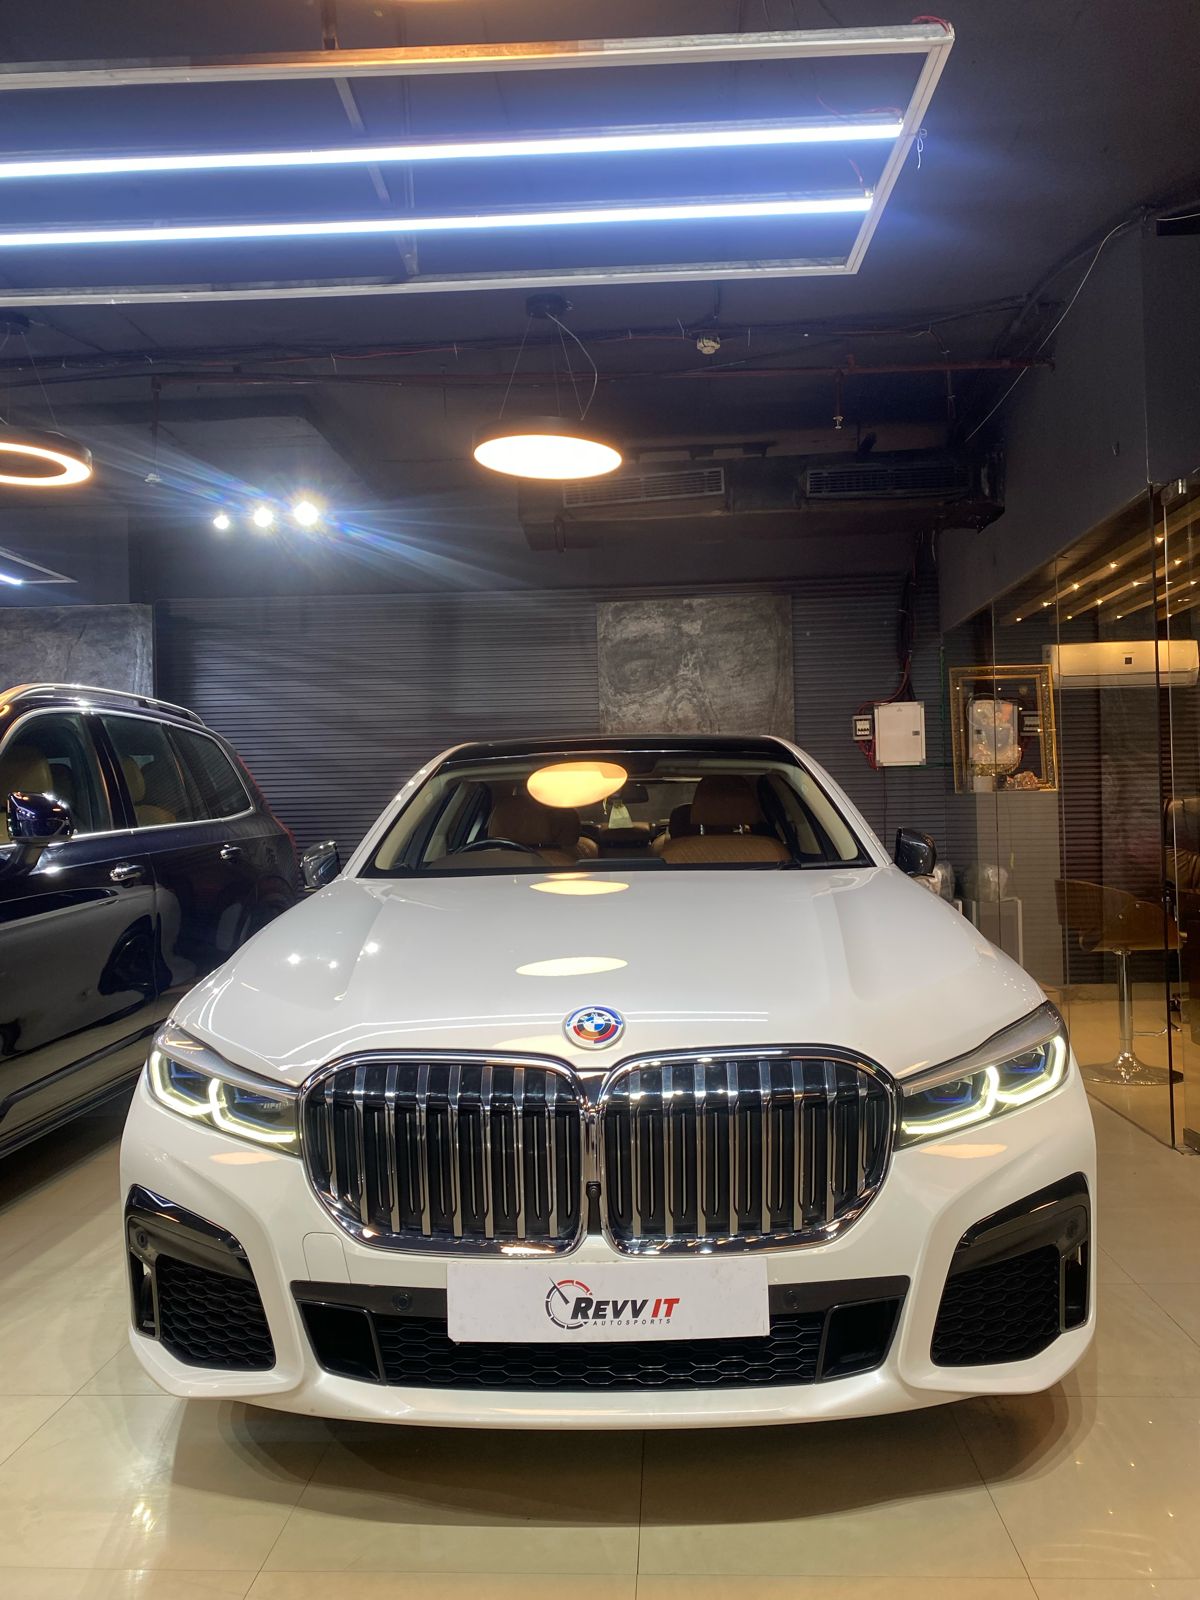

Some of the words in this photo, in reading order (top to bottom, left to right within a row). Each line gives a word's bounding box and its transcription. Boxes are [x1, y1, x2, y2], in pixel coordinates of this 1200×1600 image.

[570, 1297, 649, 1320] REVV
[651, 1298, 680, 1318] IT
[592, 1318, 671, 1326] AUTOSPORTS
